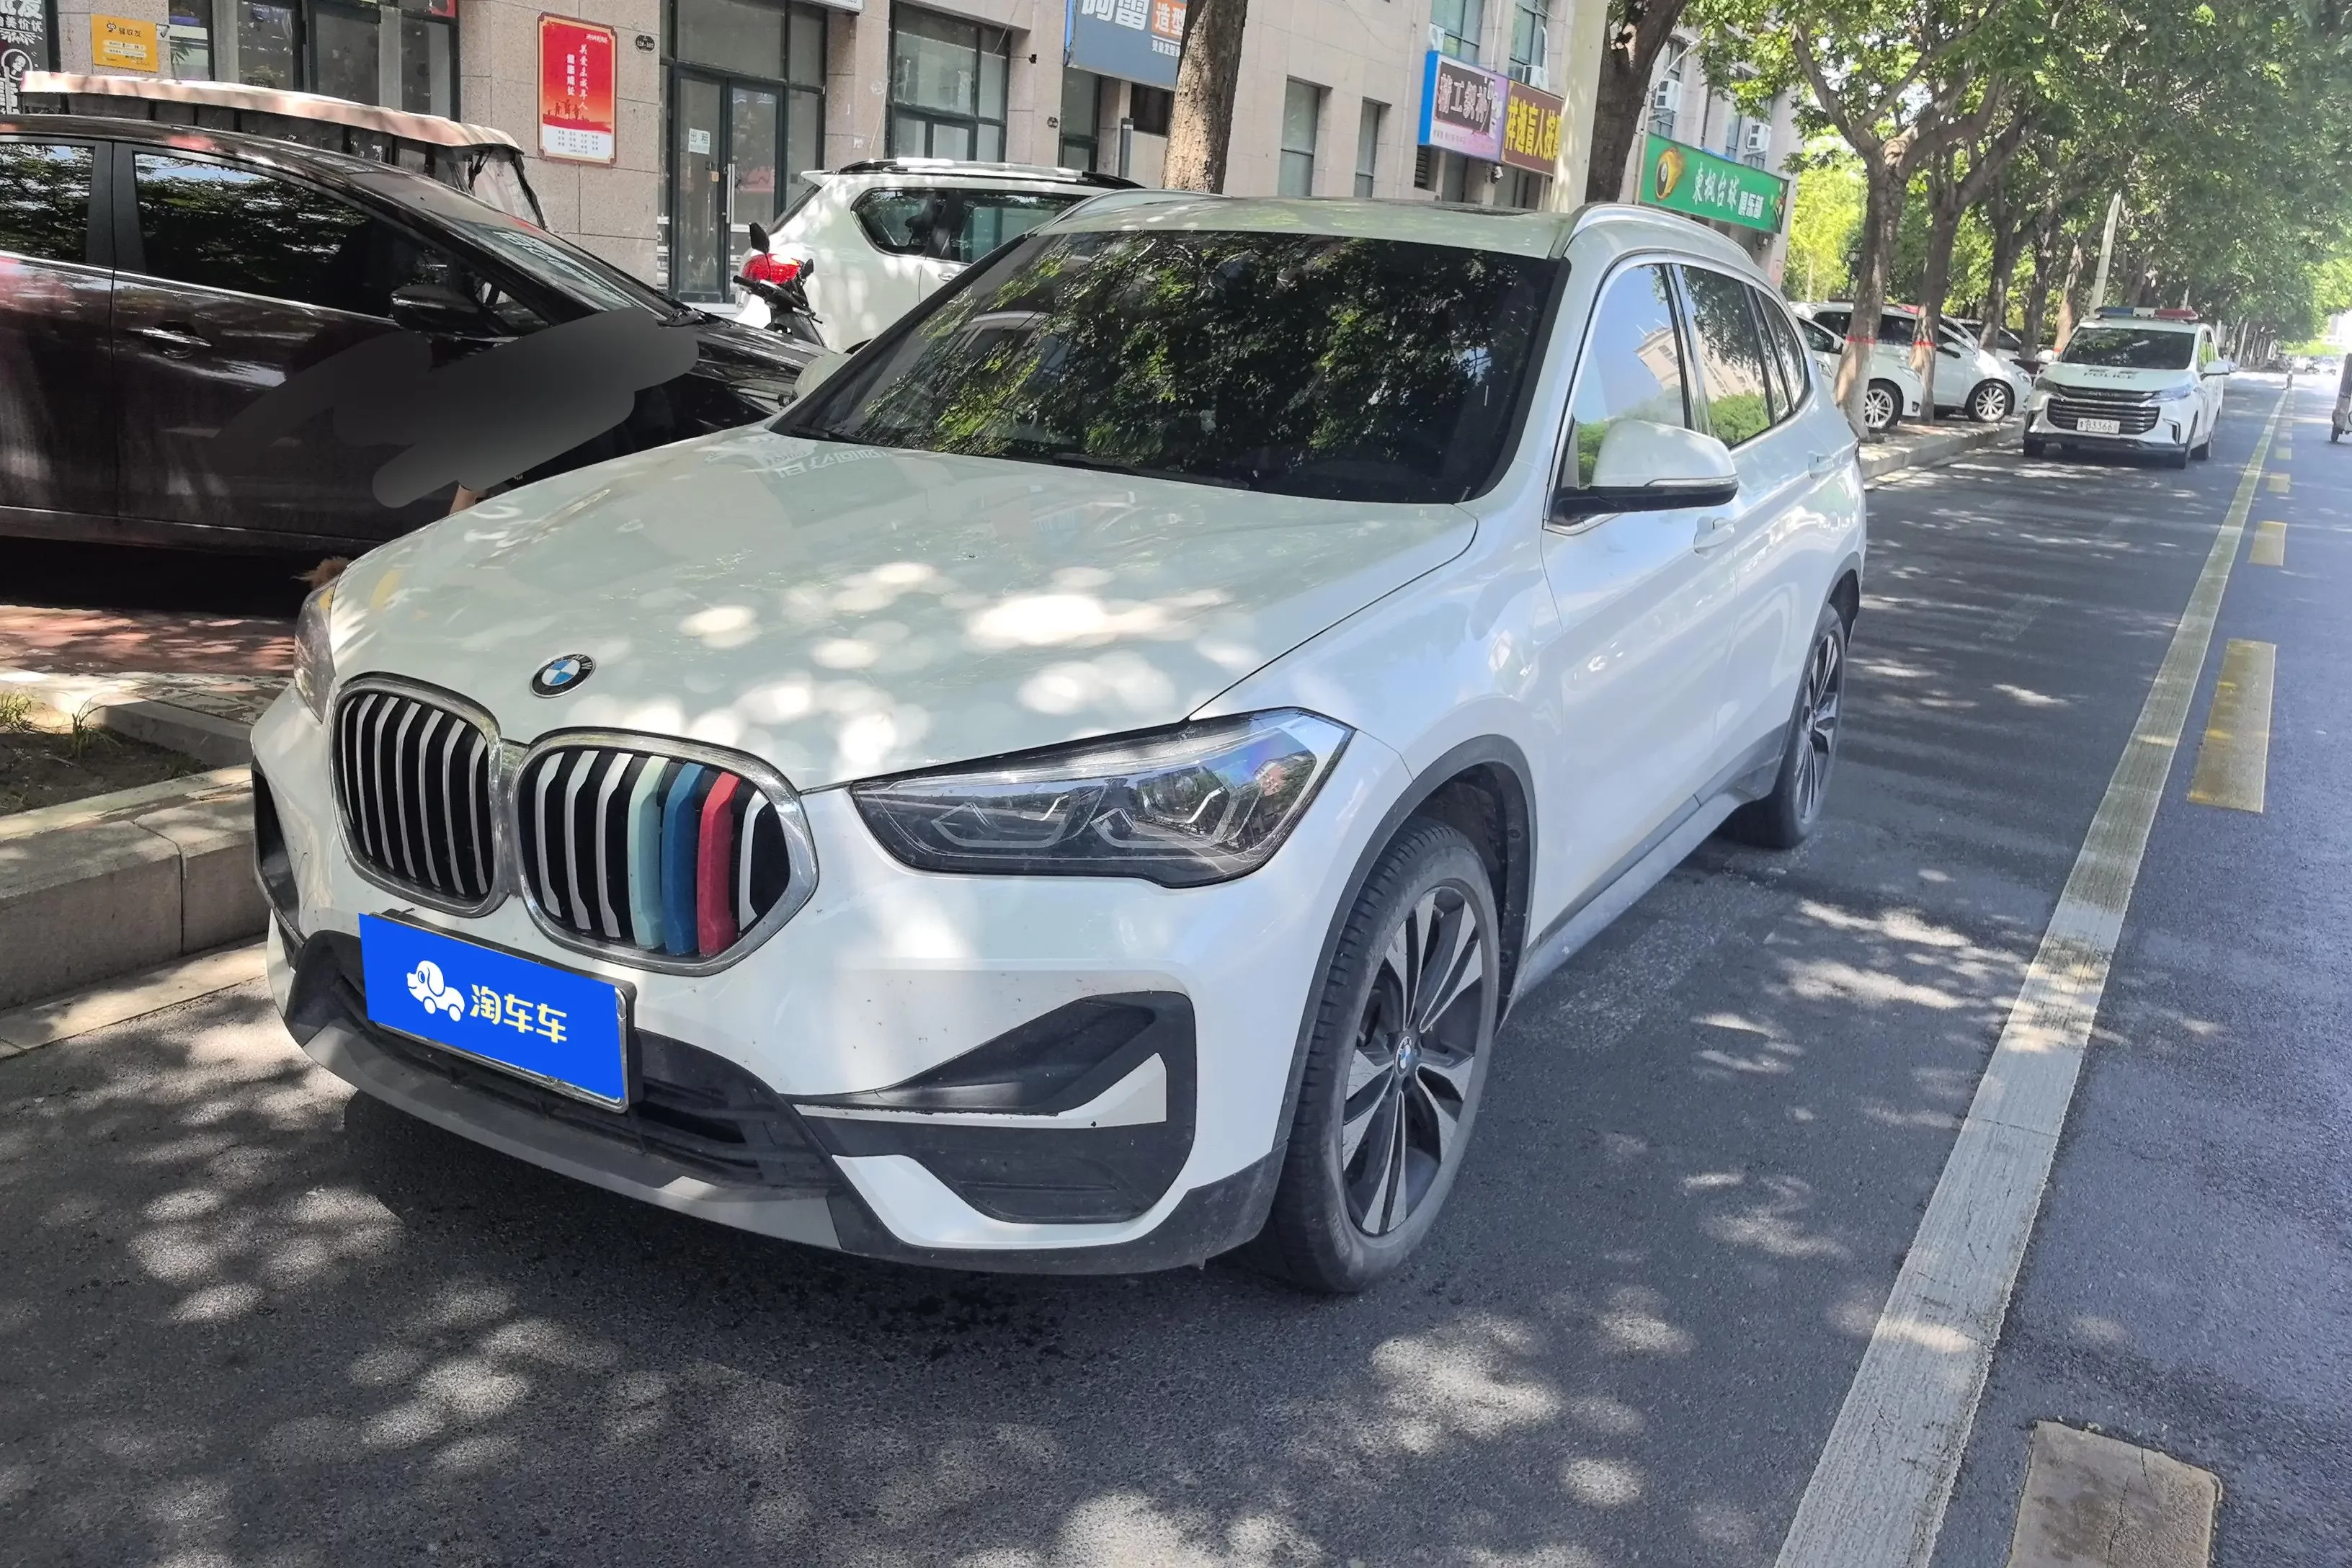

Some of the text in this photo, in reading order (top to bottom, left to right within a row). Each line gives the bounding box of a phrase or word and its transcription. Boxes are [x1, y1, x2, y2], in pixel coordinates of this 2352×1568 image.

[1154, 2, 1187, 36] 造型
[690, 130, 708, 145] 出租
[2083, 372, 2137, 380] POLICE
